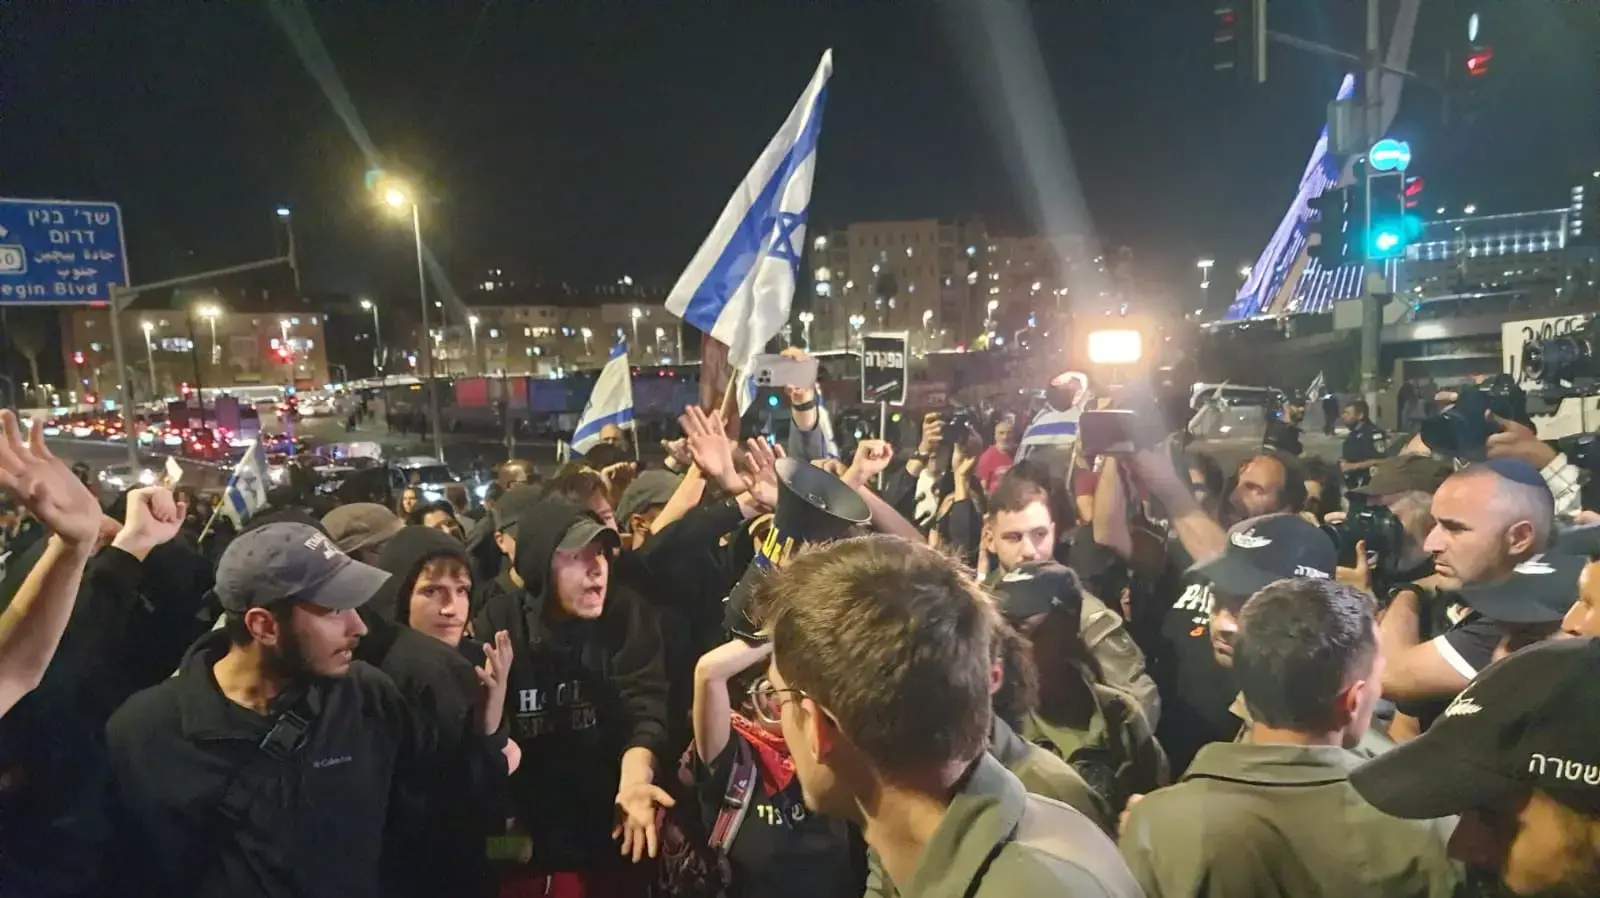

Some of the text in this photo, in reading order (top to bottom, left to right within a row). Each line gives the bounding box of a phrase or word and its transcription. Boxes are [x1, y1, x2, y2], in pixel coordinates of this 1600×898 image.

[28, 209, 65, 227] בגין
[48, 229, 95, 245] דרום
[0, 281, 98, 300] egin Blvd
[864, 350, 904, 372] הפקרה
[1528, 753, 1600, 785] שטרה
